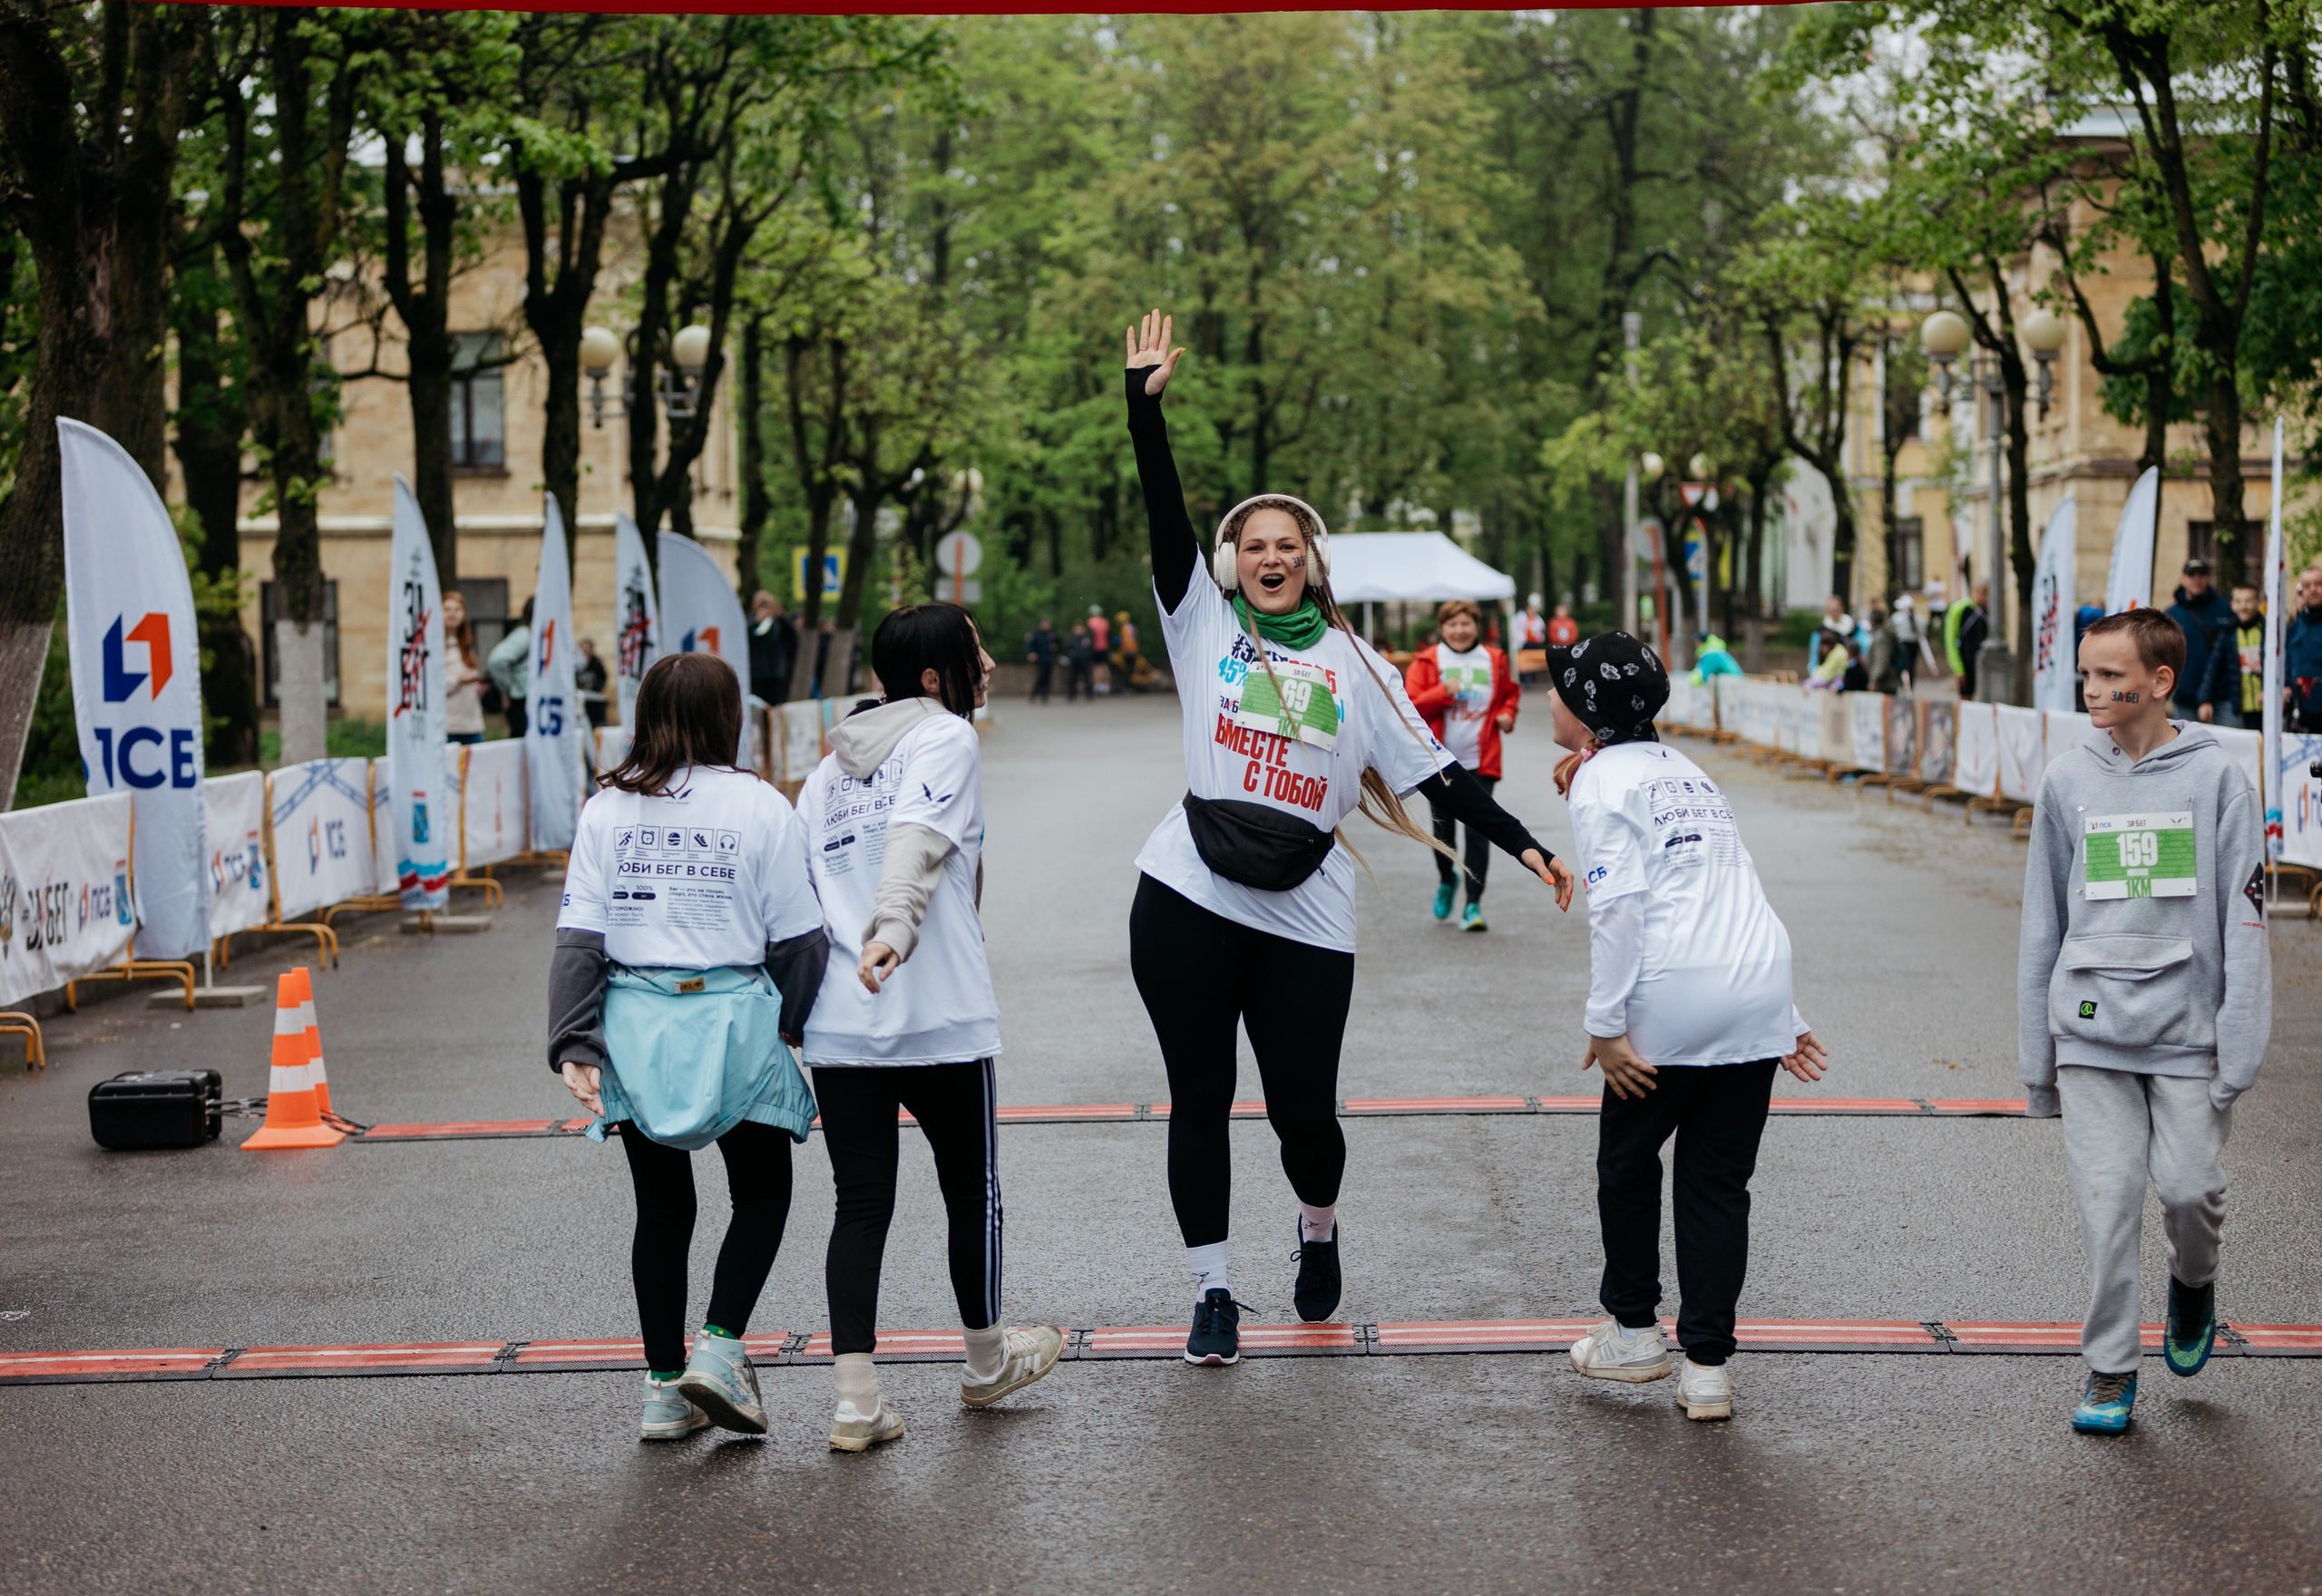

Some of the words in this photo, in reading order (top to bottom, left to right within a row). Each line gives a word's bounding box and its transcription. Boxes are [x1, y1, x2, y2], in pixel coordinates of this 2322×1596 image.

[1280, 678, 1312, 713] 69
[1215, 712, 1293, 768] ВМЕСТЕ
[1243, 760, 1262, 793] С
[1263, 765, 1328, 813] ТОБОЙ
[824, 807, 849, 828] ЛЮБИ
[874, 799, 883, 811] В
[1654, 807, 1690, 826] ЛЮБИ
[1691, 808, 1708, 819] БЕГ
[1711, 809, 1718, 818] В
[2116, 832, 2159, 867] 159
[618, 861, 651, 876] ЮБИ
[656, 864, 682, 875] БЕГ
[687, 865, 696, 876] В
[700, 866, 736, 880] СЕБЕ
